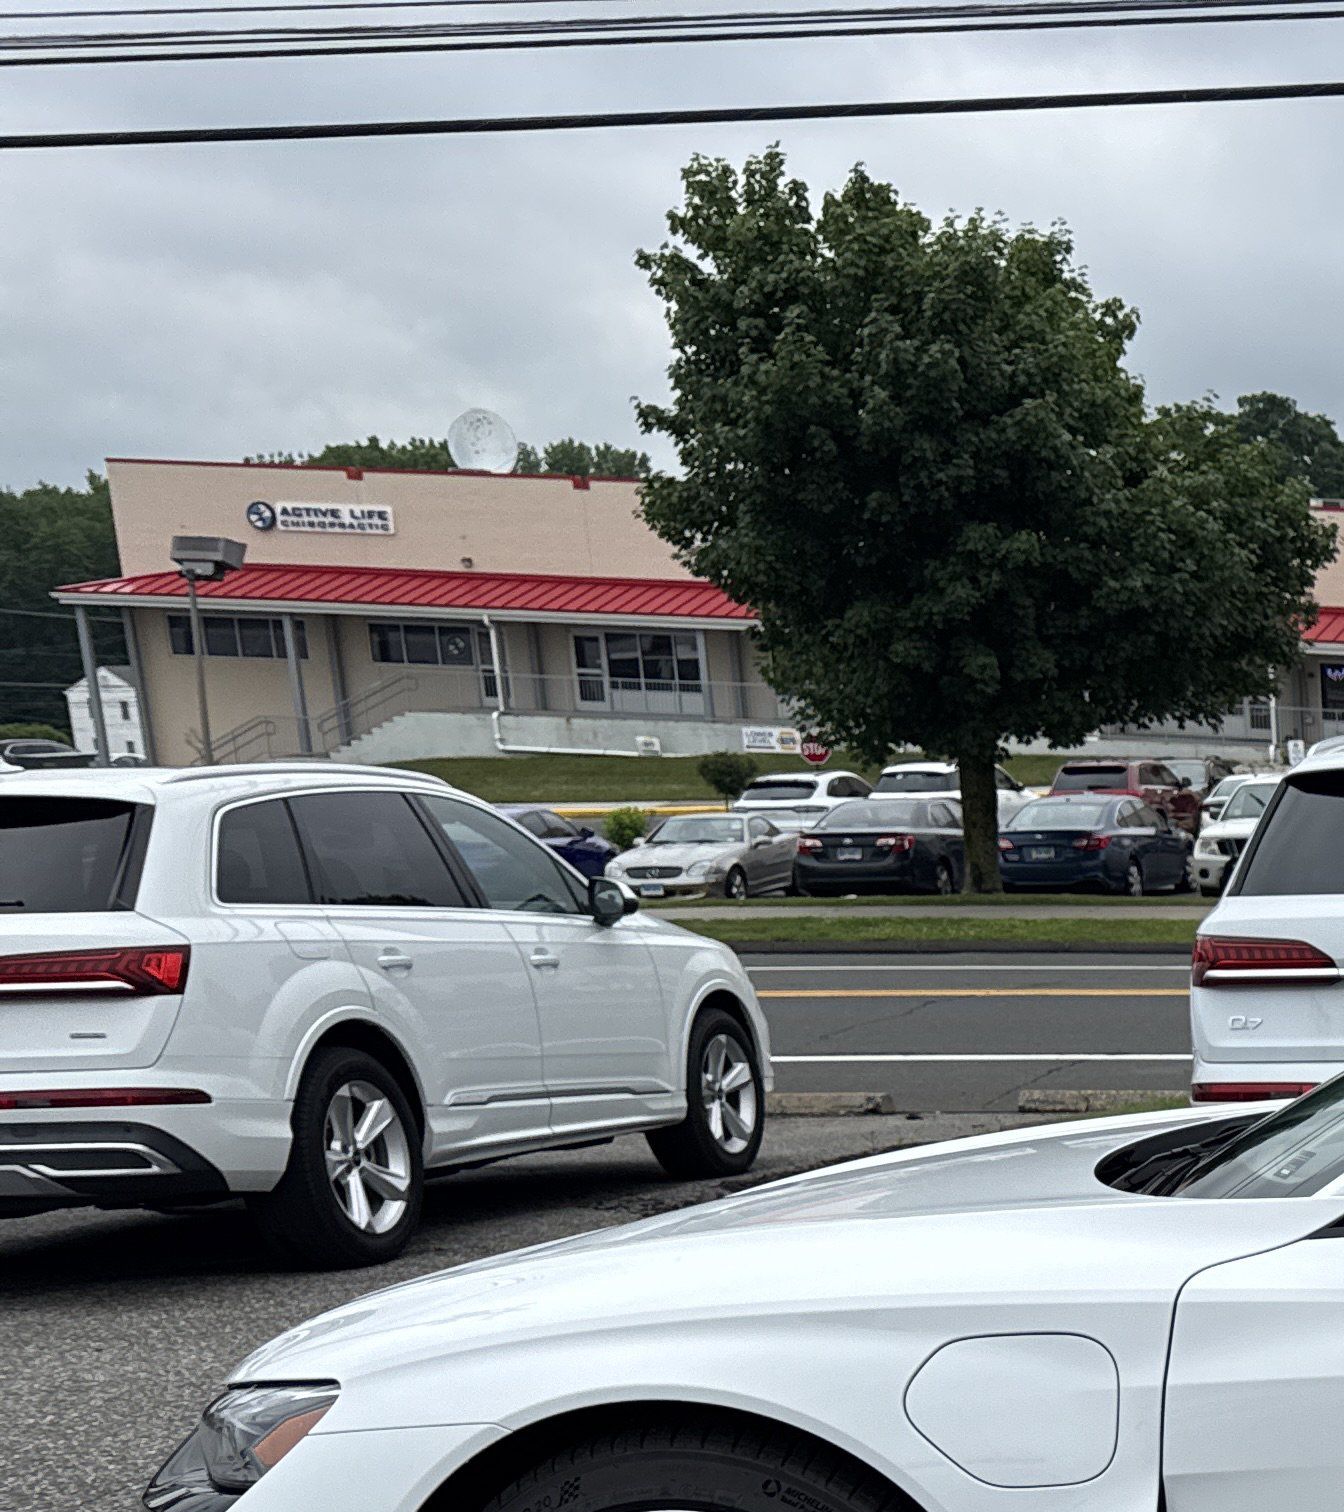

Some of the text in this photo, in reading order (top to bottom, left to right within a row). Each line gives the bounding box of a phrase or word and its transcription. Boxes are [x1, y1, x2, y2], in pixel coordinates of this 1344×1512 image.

[280, 506, 389, 521] ACTIVE LIFE
[1228, 1015, 1264, 1031] Q7
